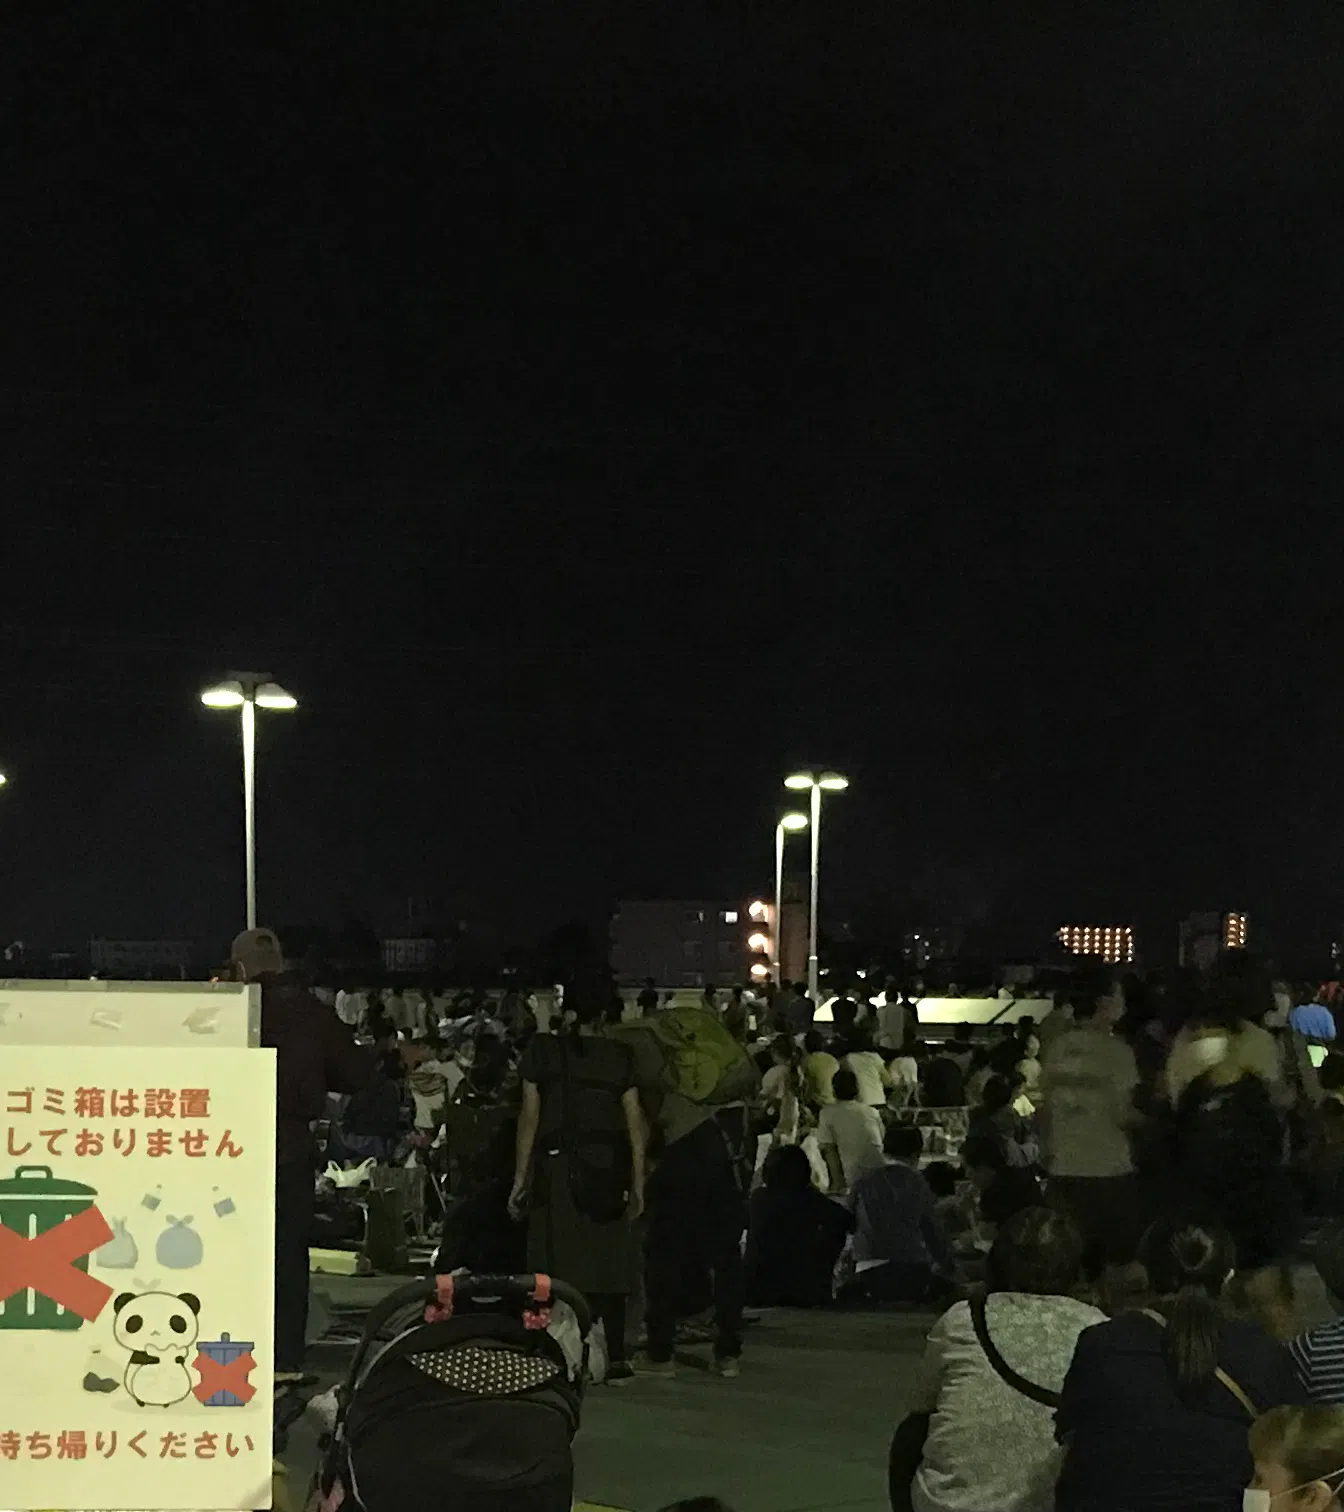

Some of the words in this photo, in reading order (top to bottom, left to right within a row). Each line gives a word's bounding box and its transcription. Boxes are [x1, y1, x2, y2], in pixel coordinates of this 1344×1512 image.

[6, 1126, 244, 1158] しておりません
